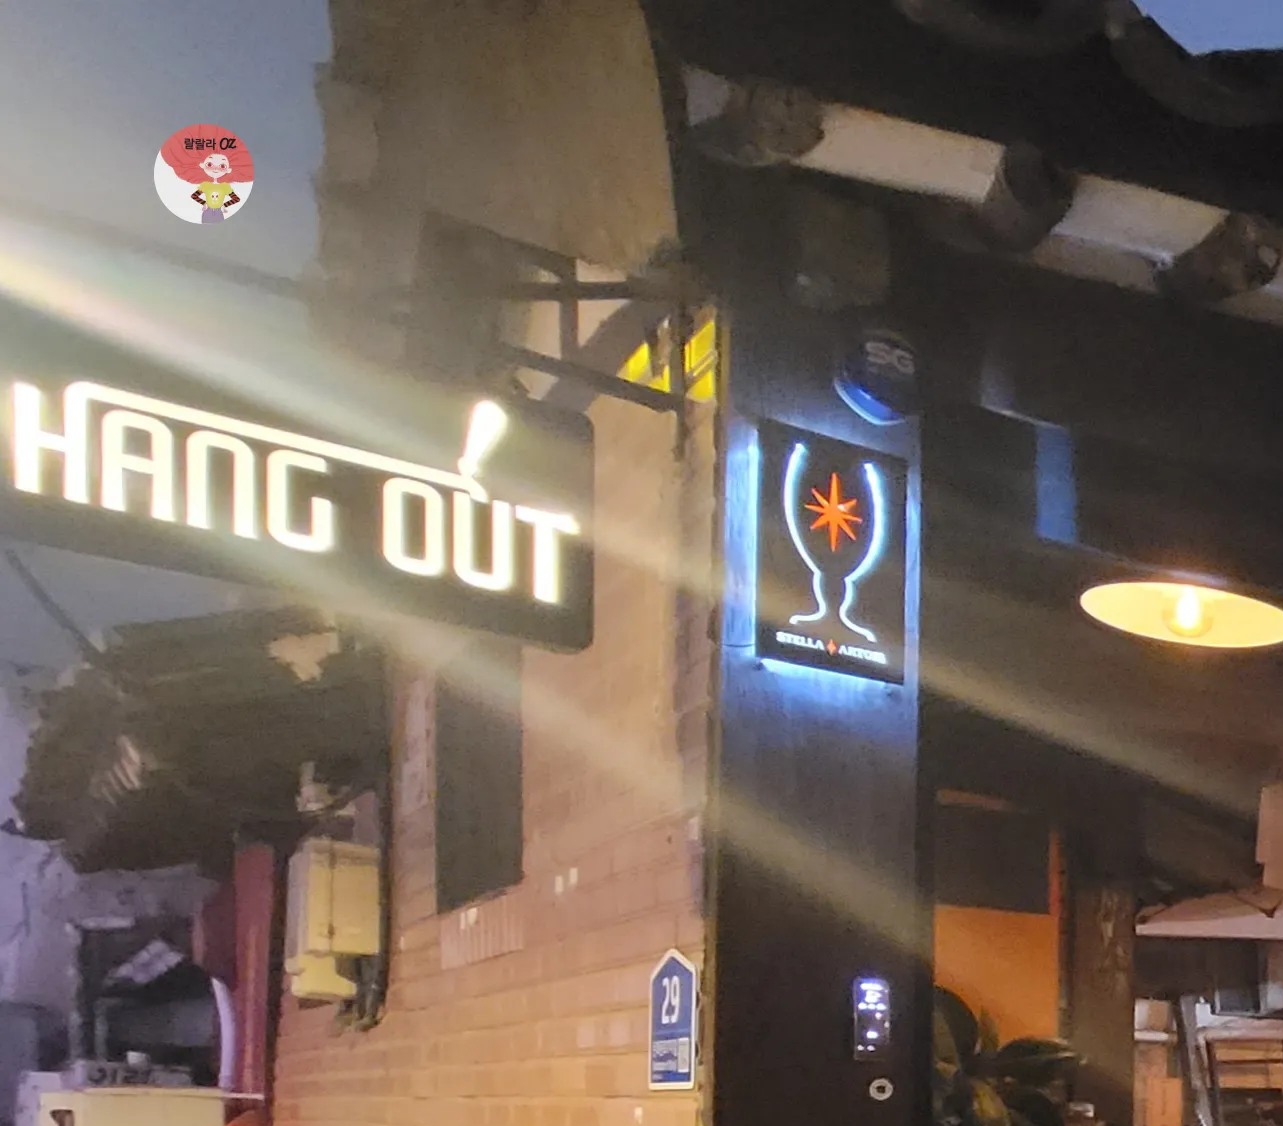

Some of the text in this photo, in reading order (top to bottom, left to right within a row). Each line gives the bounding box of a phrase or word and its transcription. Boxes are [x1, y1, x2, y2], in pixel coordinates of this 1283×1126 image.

[12, 381, 580, 604] HANG OUT
[775, 631, 887, 665] STELLA ARTO
[661, 975, 680, 1024] 29
